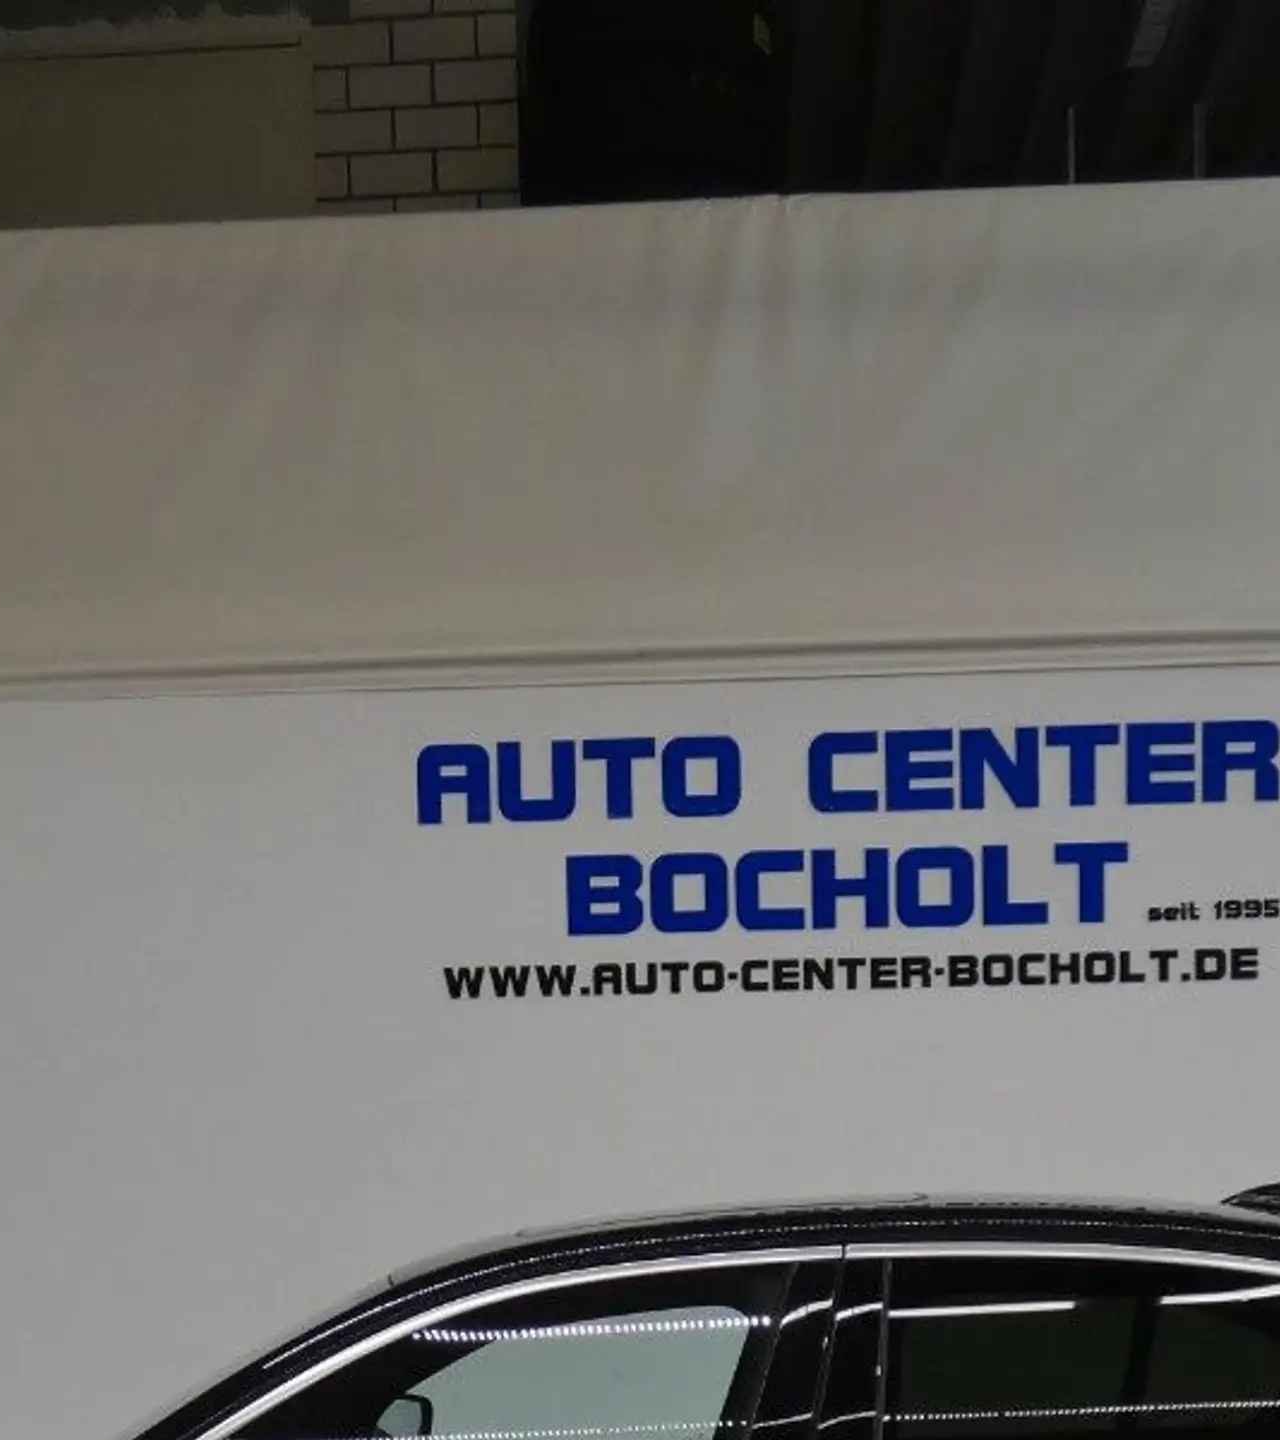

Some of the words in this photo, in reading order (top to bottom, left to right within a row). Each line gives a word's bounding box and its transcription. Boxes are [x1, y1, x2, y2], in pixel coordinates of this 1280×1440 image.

[416, 734, 744, 828] AUTO
[565, 840, 1131, 939] BOCHOLT
[1146, 900, 1202, 923] seit
[1212, 897, 1280, 921] 1995
[442, 946, 1260, 1001] WWW.AUTO-CENTER-BOCHOLT.DE
